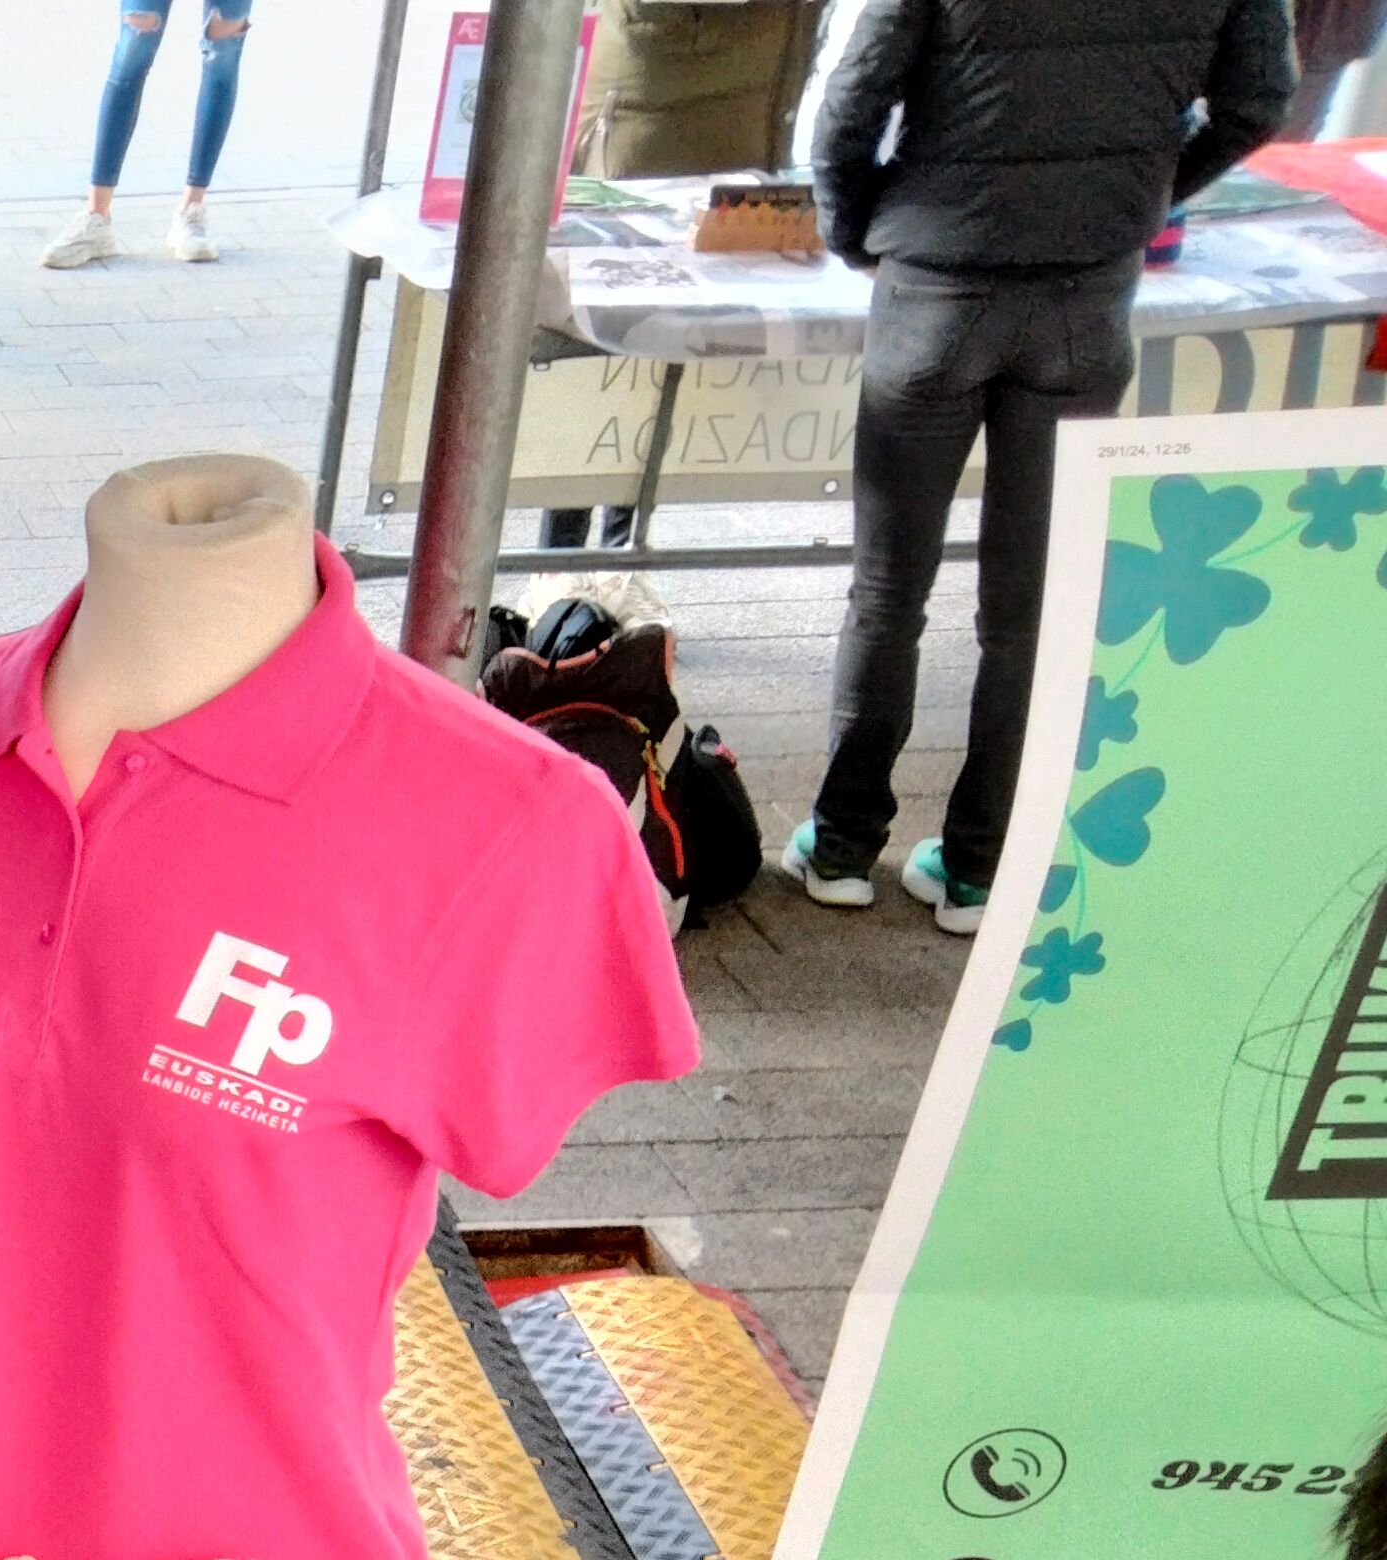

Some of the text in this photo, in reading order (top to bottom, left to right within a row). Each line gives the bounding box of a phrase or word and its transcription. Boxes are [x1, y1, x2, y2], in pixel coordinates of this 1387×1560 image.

[1098, 442, 1191, 459] 29/1/24, 12:26
[142, 1069, 299, 1133] LANBIDE HEZIKETA
[148, 1053, 303, 1117] EUSKADI
[1151, 1460, 1294, 1492] 945
